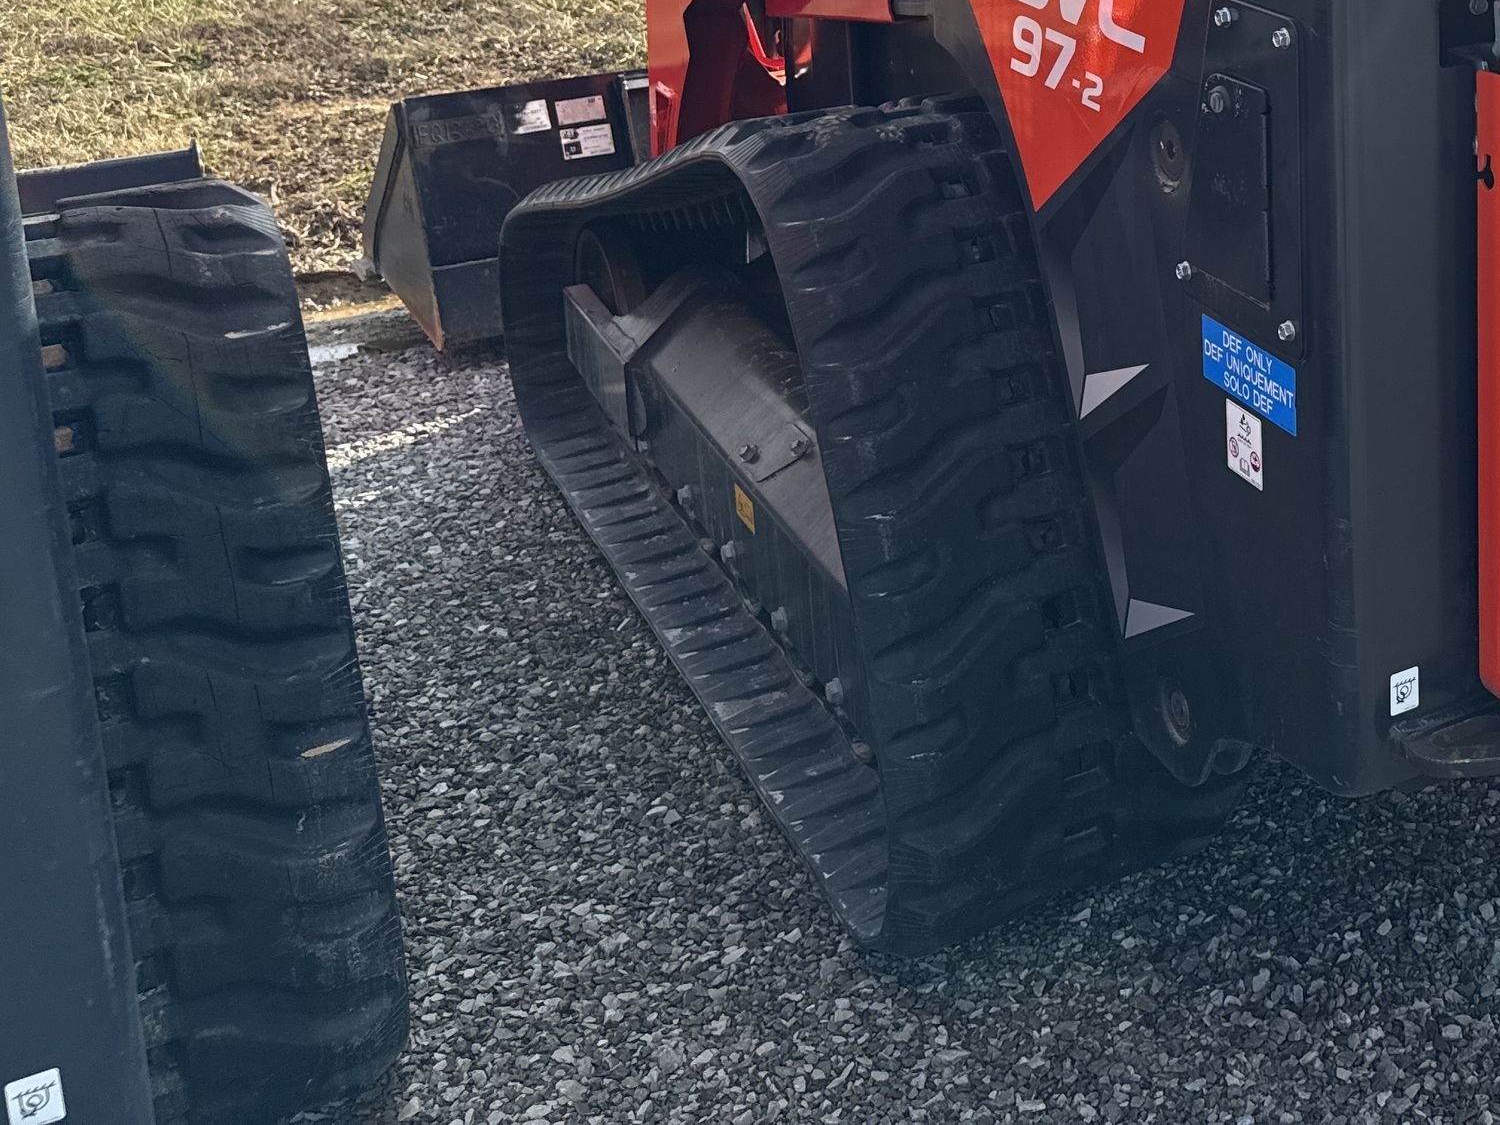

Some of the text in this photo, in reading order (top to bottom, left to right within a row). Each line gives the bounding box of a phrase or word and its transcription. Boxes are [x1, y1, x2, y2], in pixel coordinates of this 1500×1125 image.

[1010, 15, 1103, 111] 97-2
[1204, 339, 1294, 409] DEF UNIQUEMENT
[1223, 331, 1272, 374] DEF ONLY
[1223, 372, 1273, 414] SOLO DEF
